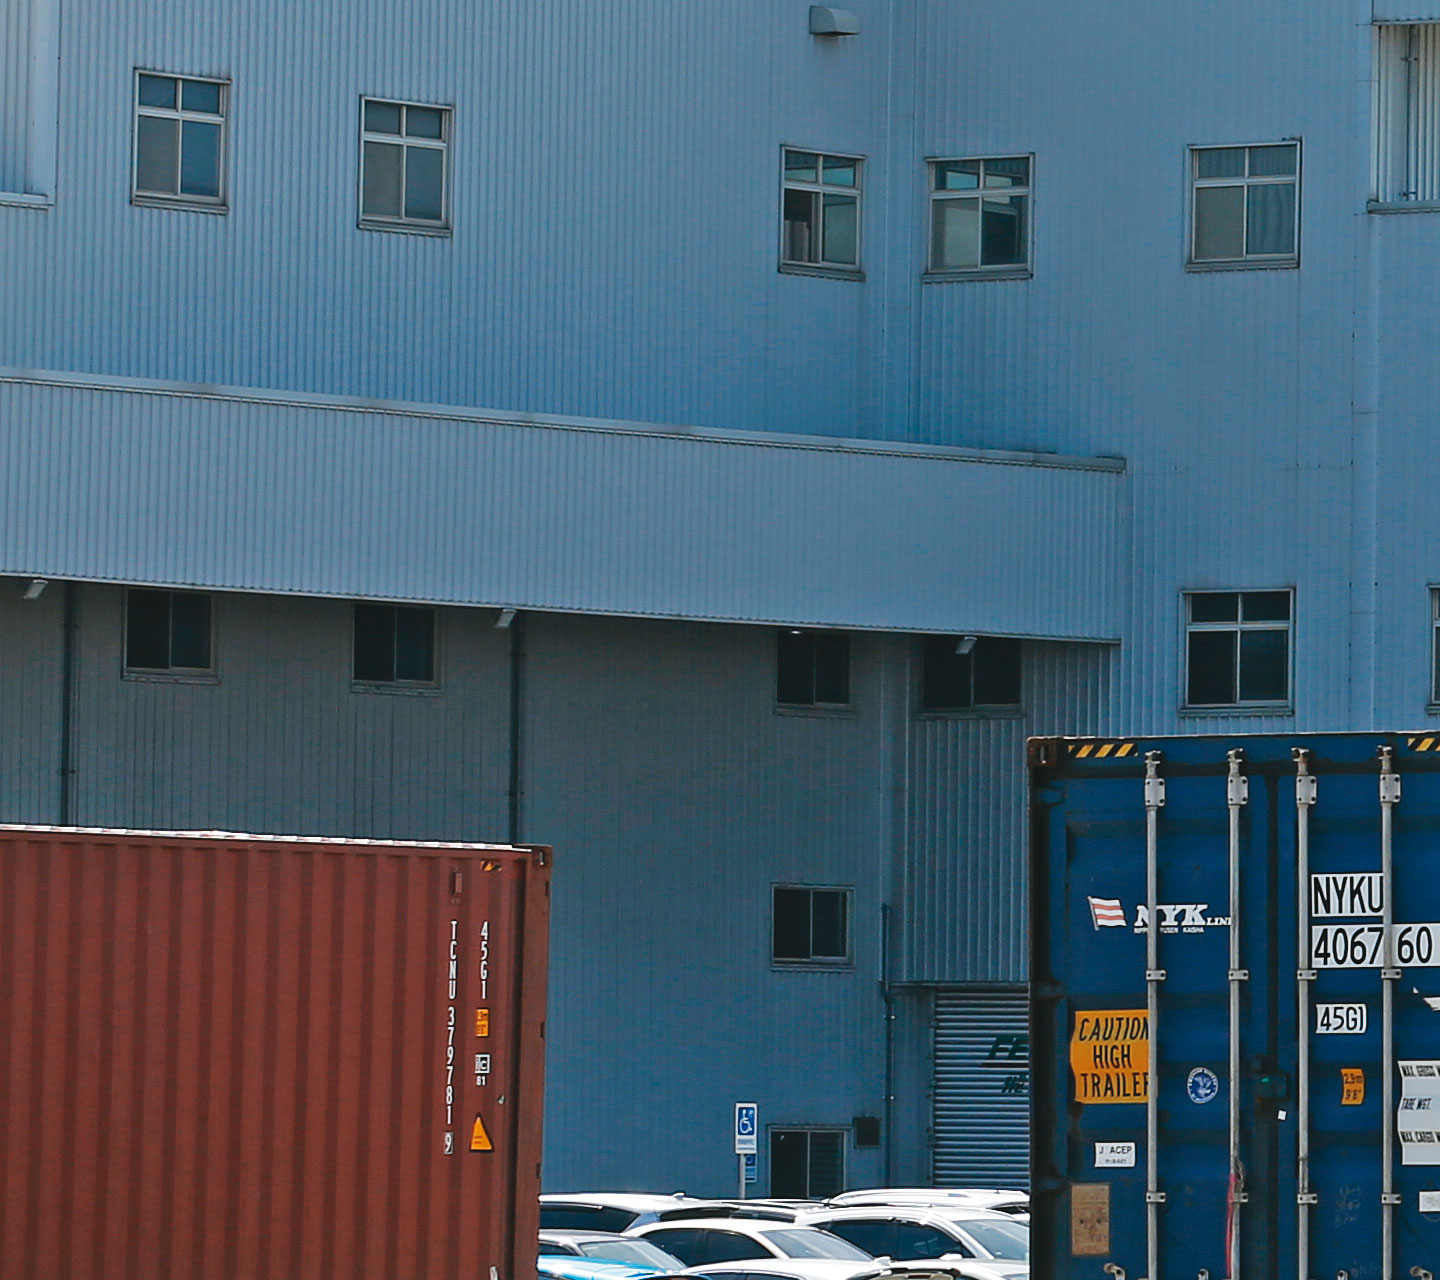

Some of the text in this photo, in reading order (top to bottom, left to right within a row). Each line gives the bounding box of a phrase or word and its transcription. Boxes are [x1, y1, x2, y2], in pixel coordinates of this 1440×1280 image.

[1313, 876, 1384, 914] NYKU
[1134, 904, 1208, 926] NYK
[480, 921, 489, 1000] 45G1
[1320, 1006, 1364, 1031] 45G1
[444, 921, 458, 1154] TCNU 379781 9
[1093, 1045, 1132, 1069] HIGH
